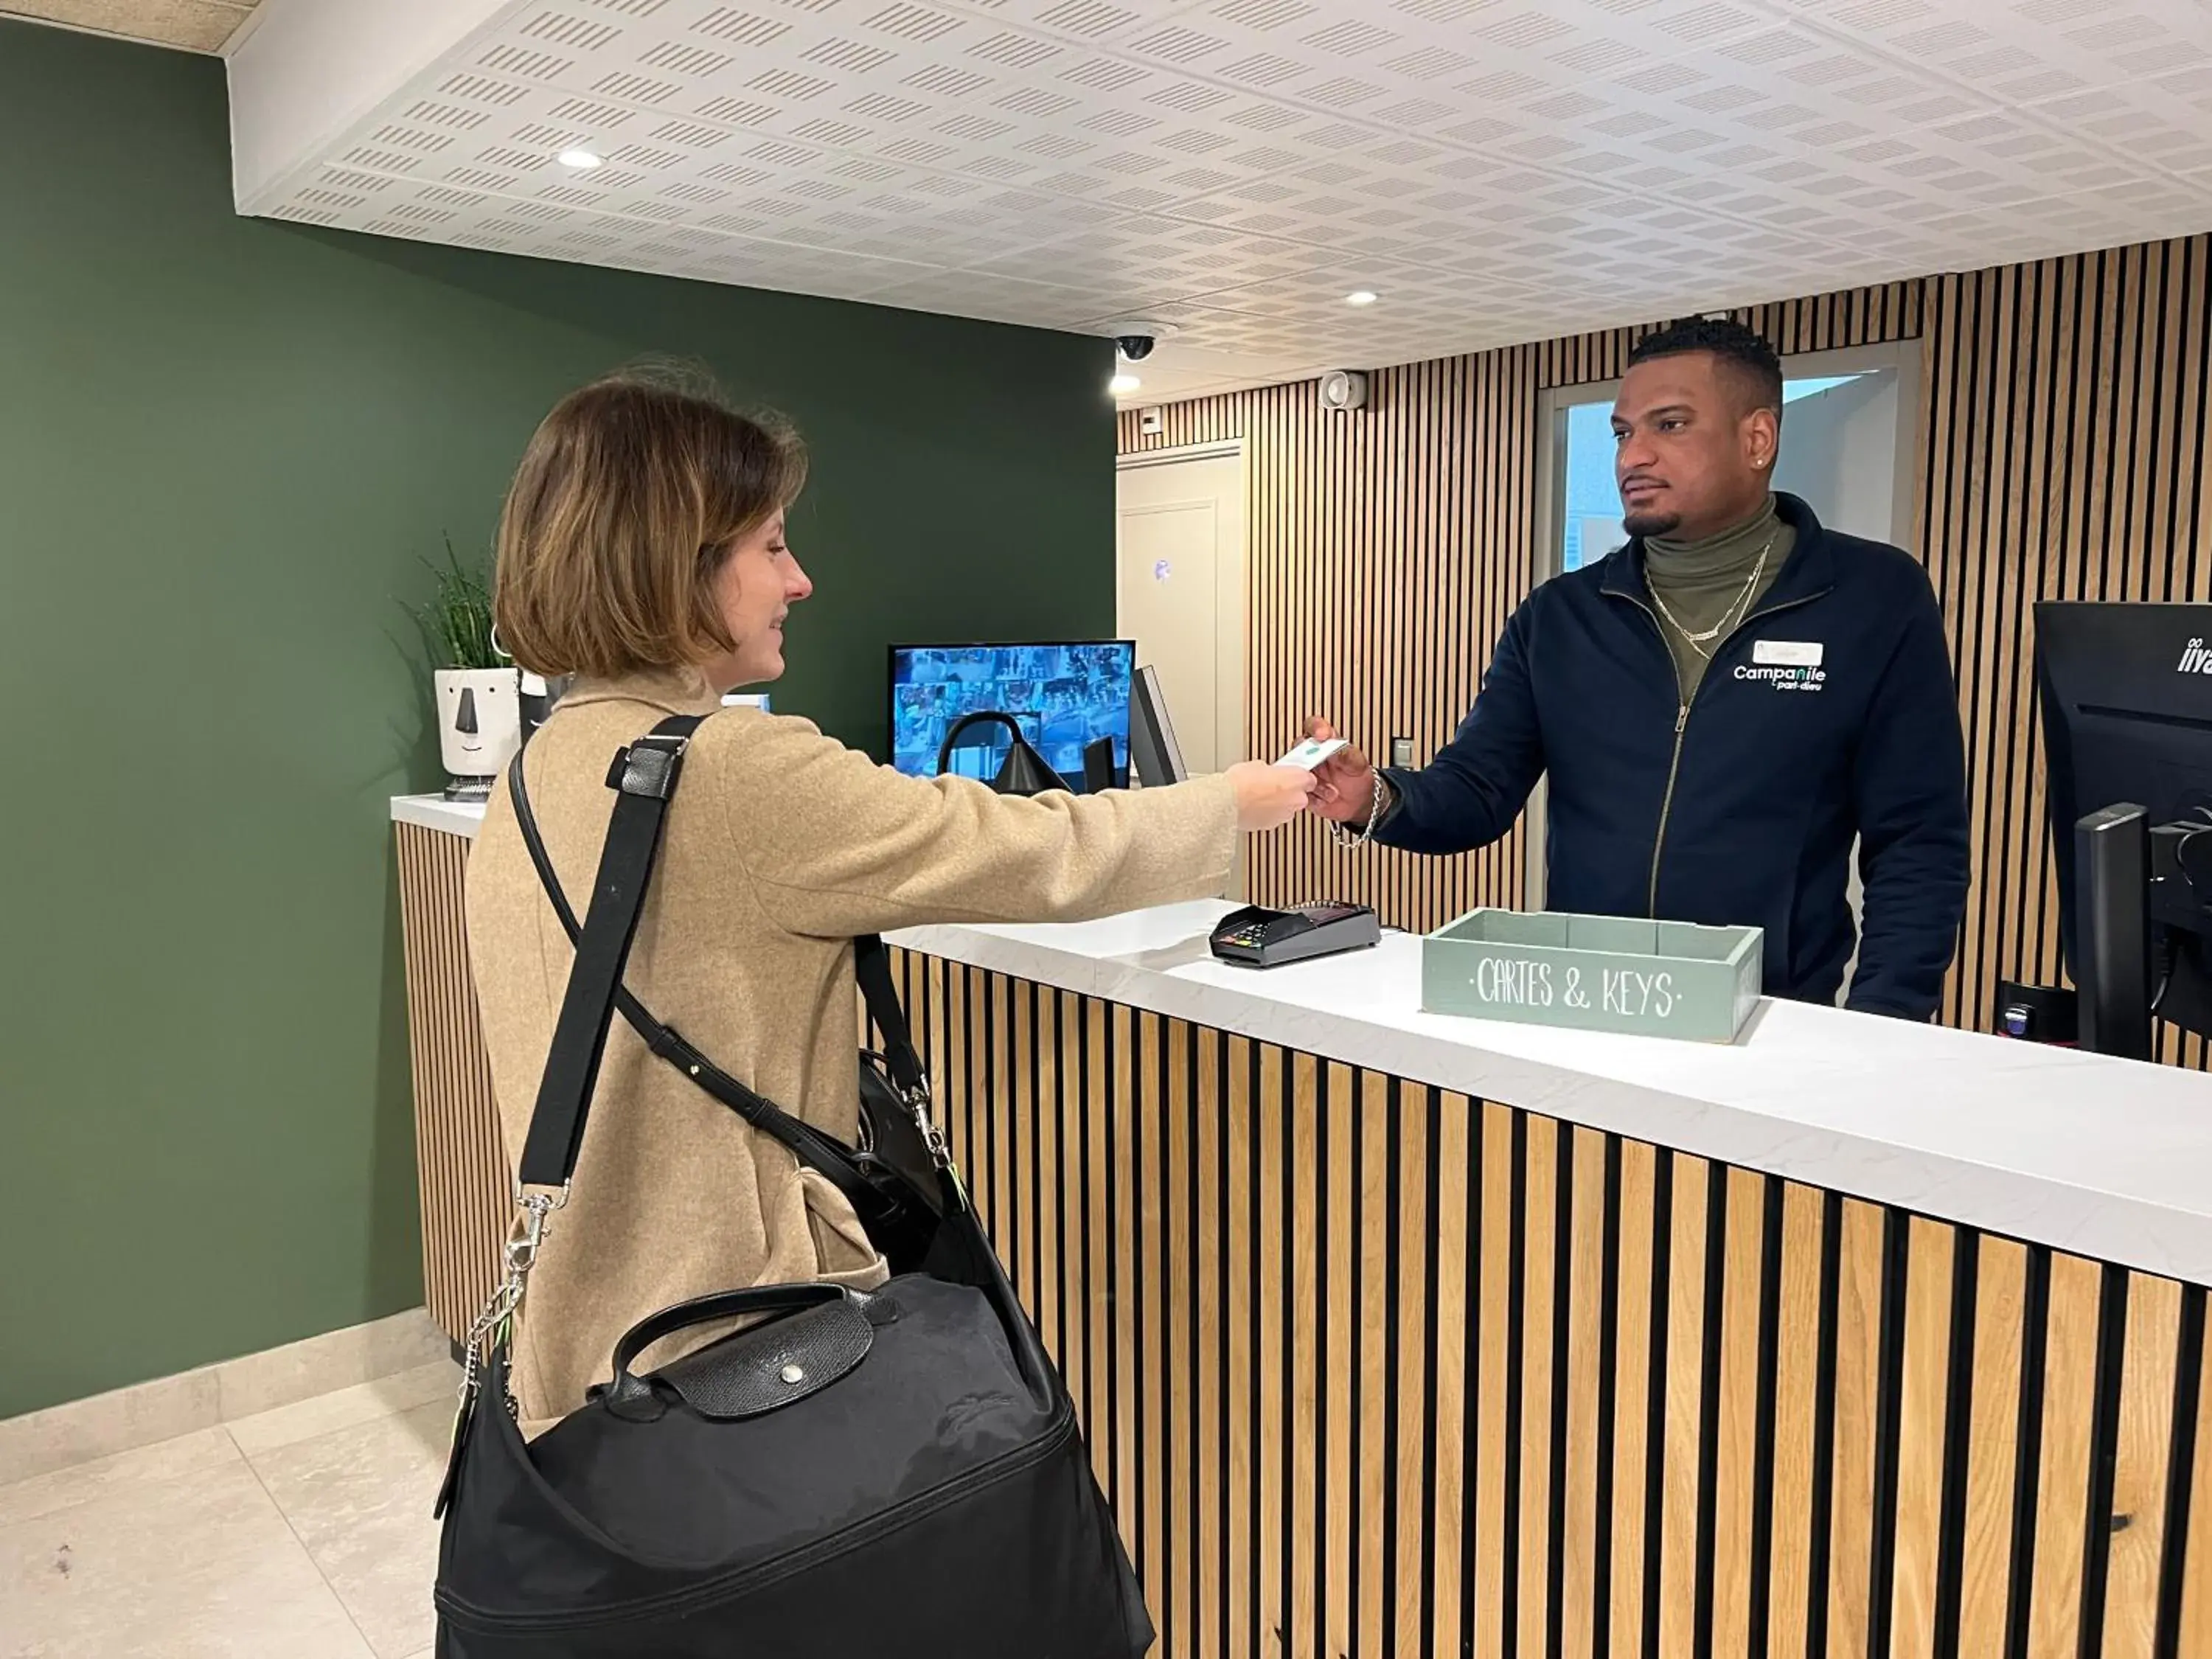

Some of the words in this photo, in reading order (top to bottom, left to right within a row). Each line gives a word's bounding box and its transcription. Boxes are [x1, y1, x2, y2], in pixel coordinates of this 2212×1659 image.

[1733, 665, 1826, 681] Campanile
[1478, 957, 1554, 1006] CARTES
[1563, 967, 1590, 1009] &
[1603, 969, 1672, 1018] KEYS
